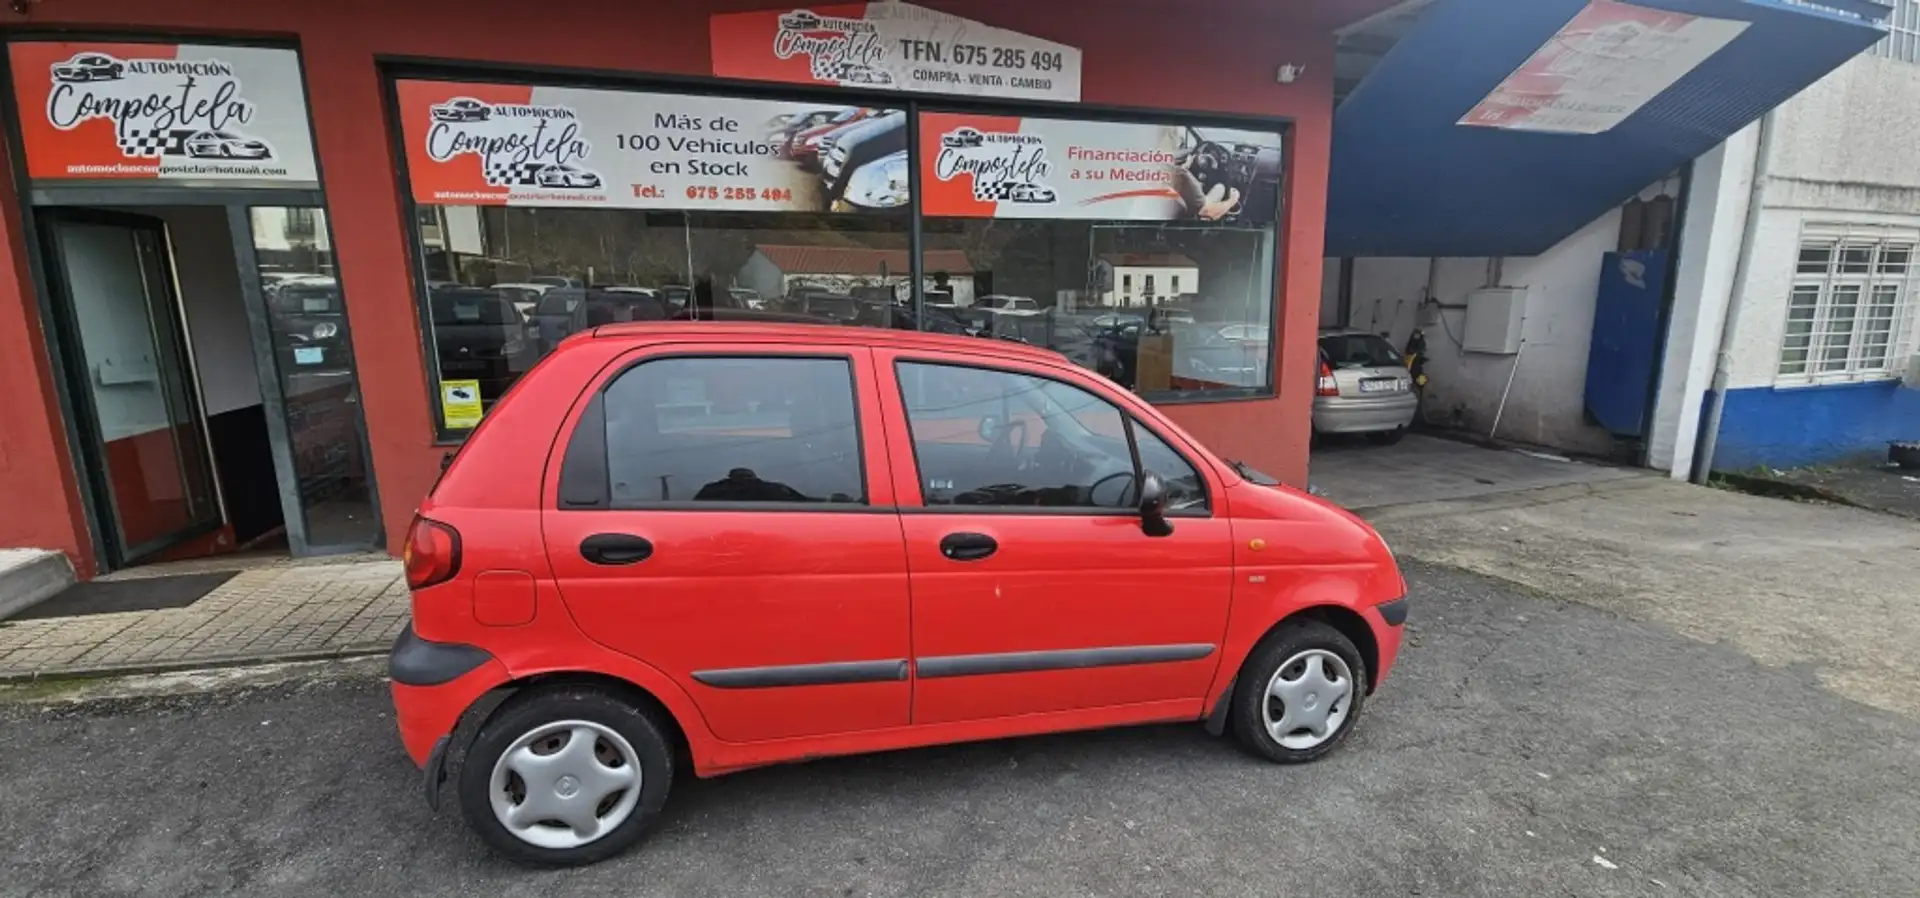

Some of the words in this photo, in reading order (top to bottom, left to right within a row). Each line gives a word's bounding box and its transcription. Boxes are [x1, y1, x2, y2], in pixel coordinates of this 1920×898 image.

[776, 29, 884, 63] Compostela
[900, 39, 947, 63] TFN.
[953, 45, 987, 65] 675
[992, 48, 1025, 68] 285
[1031, 51, 1063, 72] 494
[128, 61, 230, 76] AUTOMOCIÓN
[913, 69, 961, 83] COMPRA
[969, 74, 1003, 87] VENTA
[1010, 77, 1052, 90] CAMBIO
[50, 76, 252, 138] Compostela
[494, 104, 575, 119] AUTOMOCIÓN
[654, 113, 701, 130] Más
[709, 116, 738, 132] de
[429, 119, 590, 170] Compostela
[616, 134, 660, 151] 100
[1067, 146, 1174, 163] Financiación
[651, 162, 680, 174] en
[688, 159, 749, 177] Stock
[937, 144, 1051, 187] Compostela
[1070, 169, 1081, 181] a
[1085, 170, 1105, 182] su
[1109, 168, 1171, 182] Medida
[686, 186, 719, 200] 675
[761, 188, 792, 201] 494
